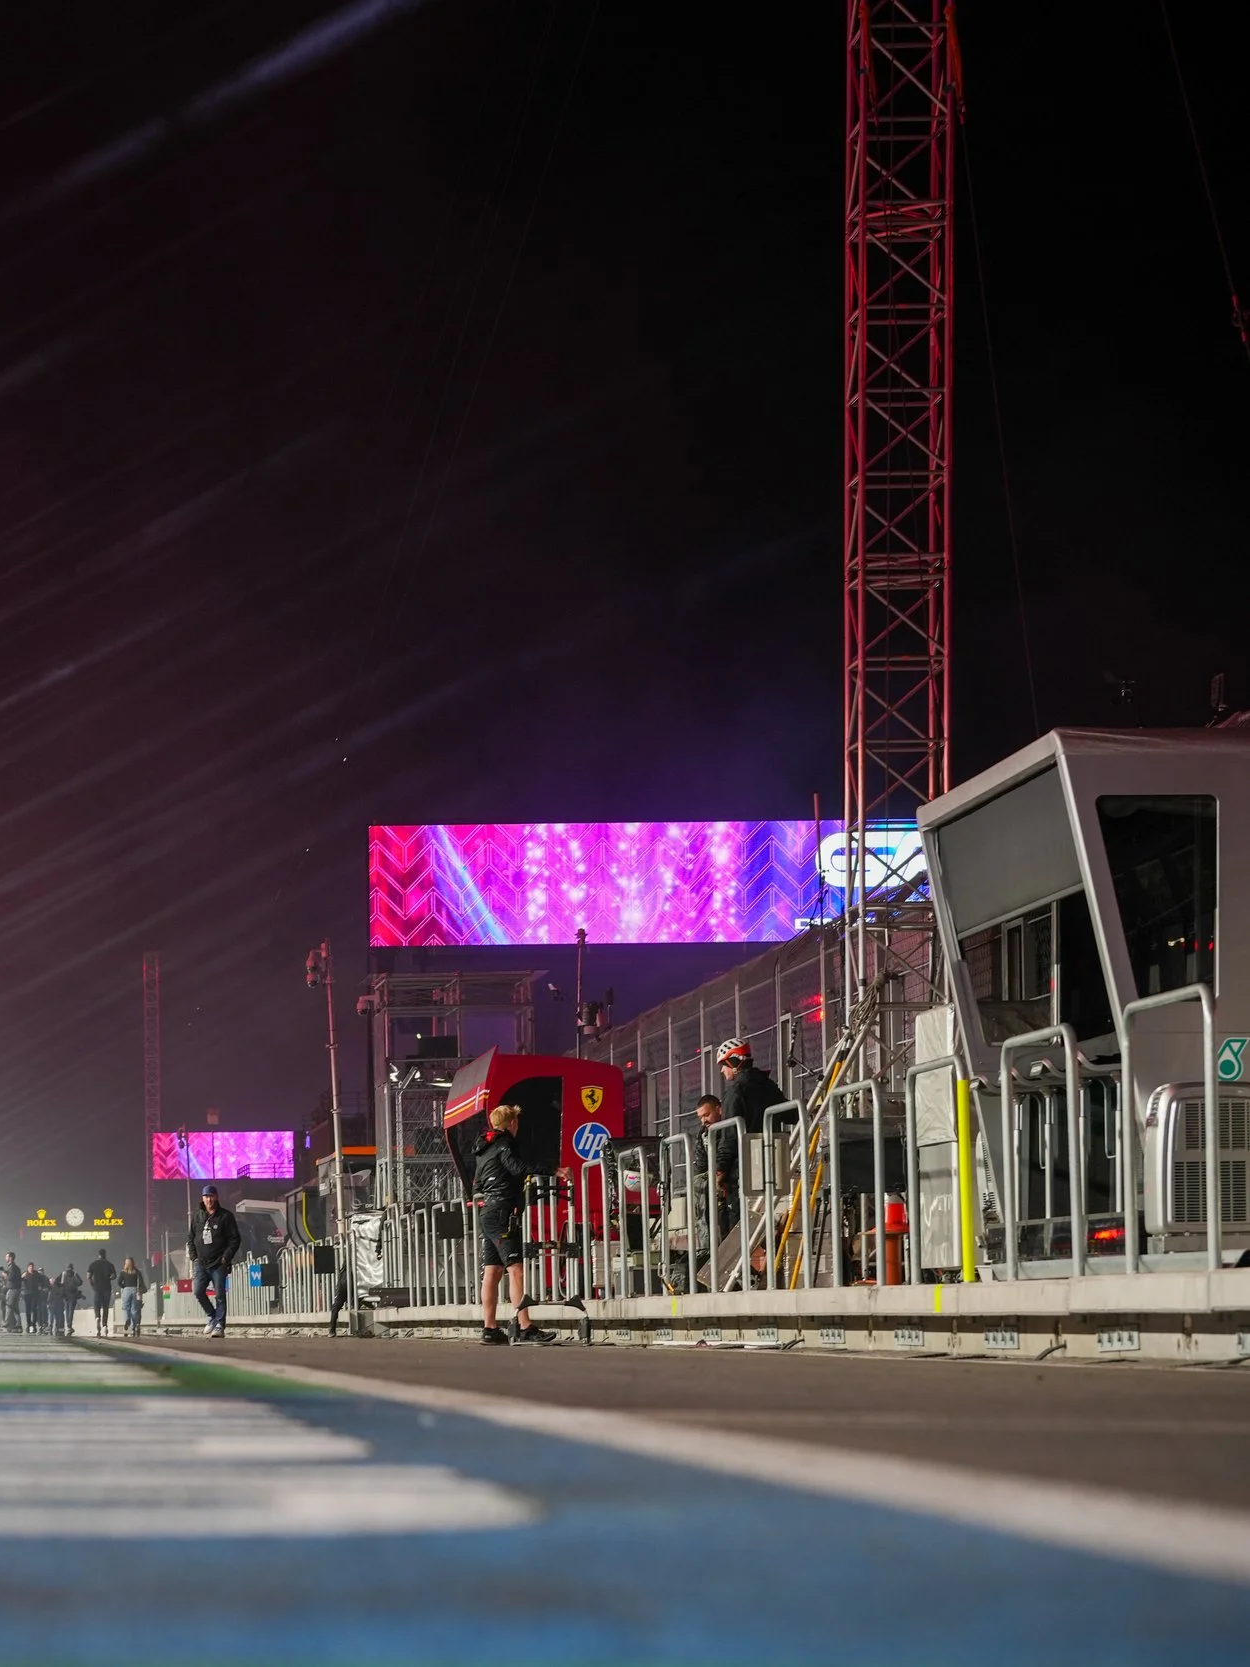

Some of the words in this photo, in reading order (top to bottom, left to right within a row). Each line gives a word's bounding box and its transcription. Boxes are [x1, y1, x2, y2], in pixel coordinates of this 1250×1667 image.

[578, 1123, 608, 1160] hp
[26, 1219, 57, 1227] ROLEX
[93, 1218, 124, 1226] ROLEX
